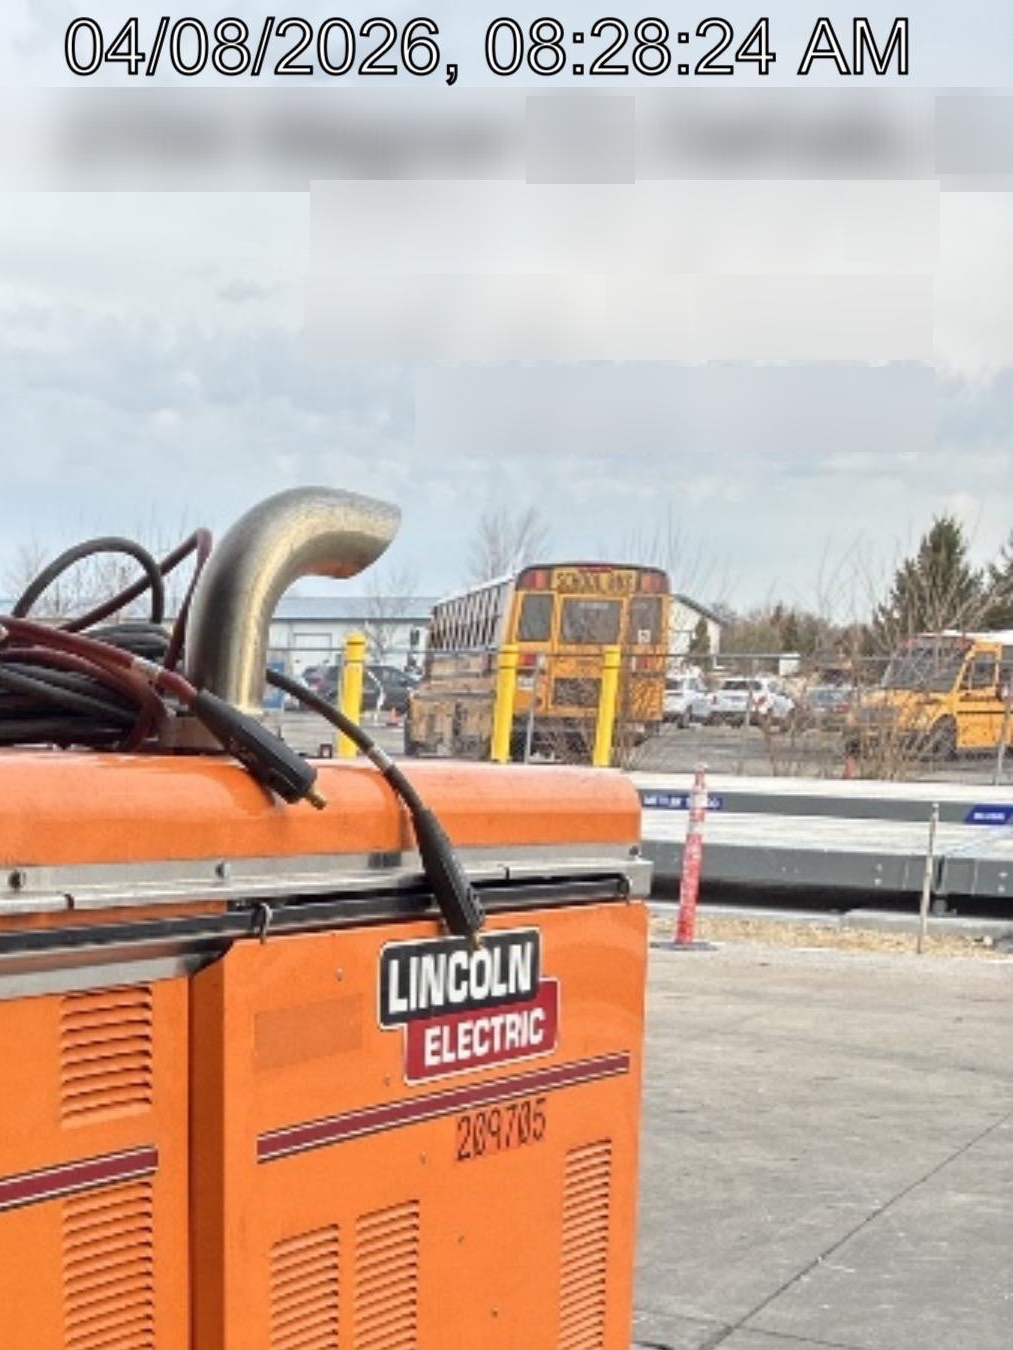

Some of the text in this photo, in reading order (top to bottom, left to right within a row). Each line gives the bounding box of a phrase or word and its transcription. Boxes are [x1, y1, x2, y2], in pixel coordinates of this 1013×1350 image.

[387, 941, 536, 1015] LINCOLN
[423, 1007, 547, 1068] ELECTRIC
[455, 1098, 547, 1163] 209705
